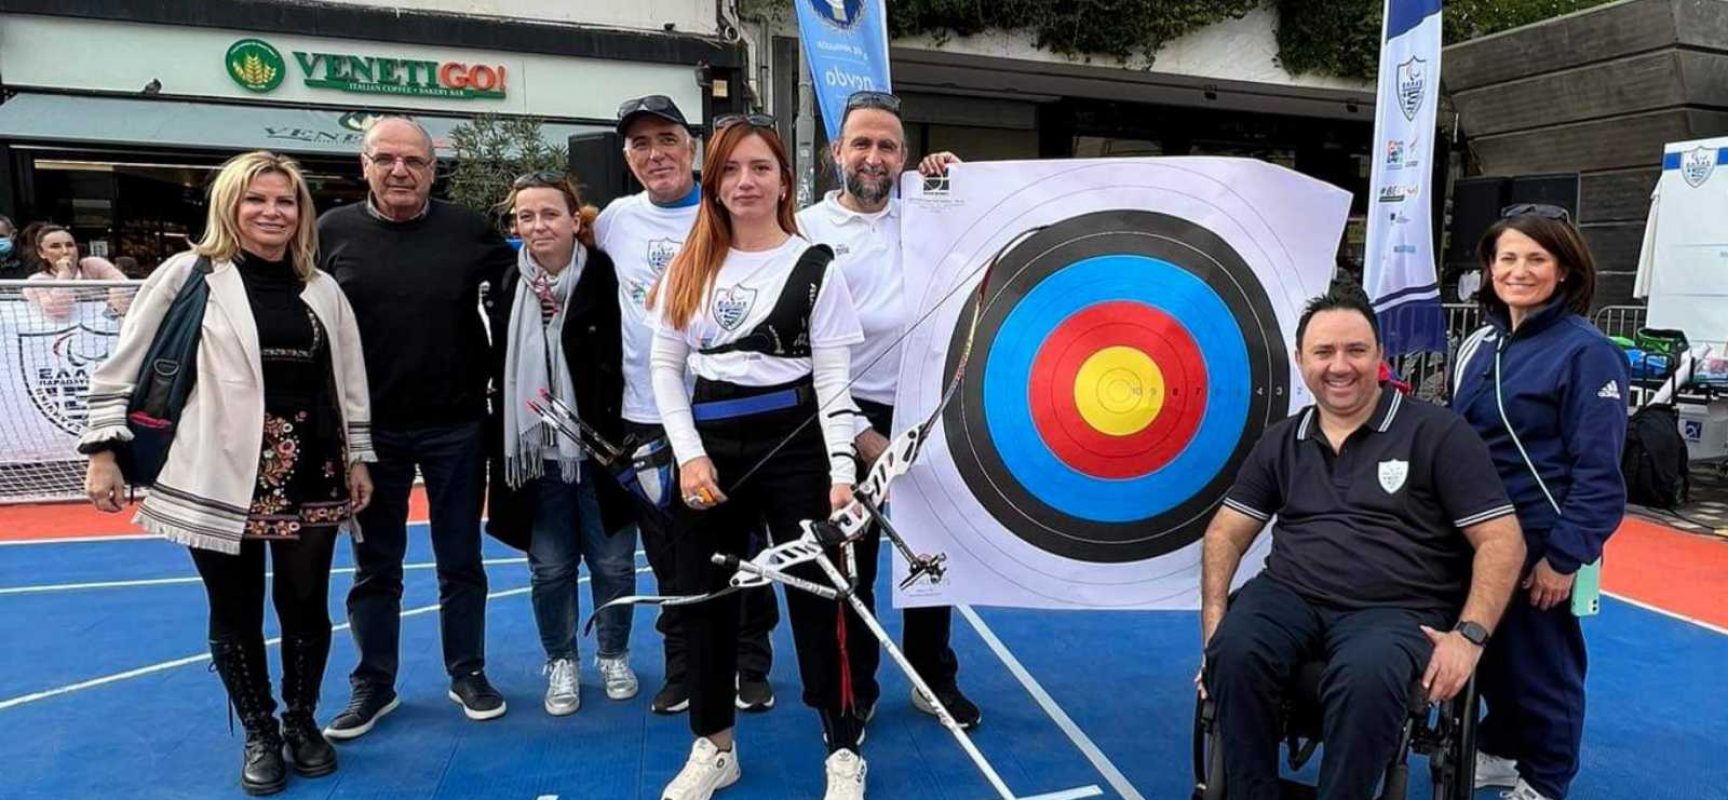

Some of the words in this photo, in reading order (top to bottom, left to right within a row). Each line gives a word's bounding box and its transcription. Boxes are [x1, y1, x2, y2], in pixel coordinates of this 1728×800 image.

[349, 82, 381, 92] ITALIAN
[382, 84, 412, 94] COFFEE
[419, 87, 448, 96] BAKERY
[449, 89, 464, 97] BAR
[264, 127, 364, 146] VENE
